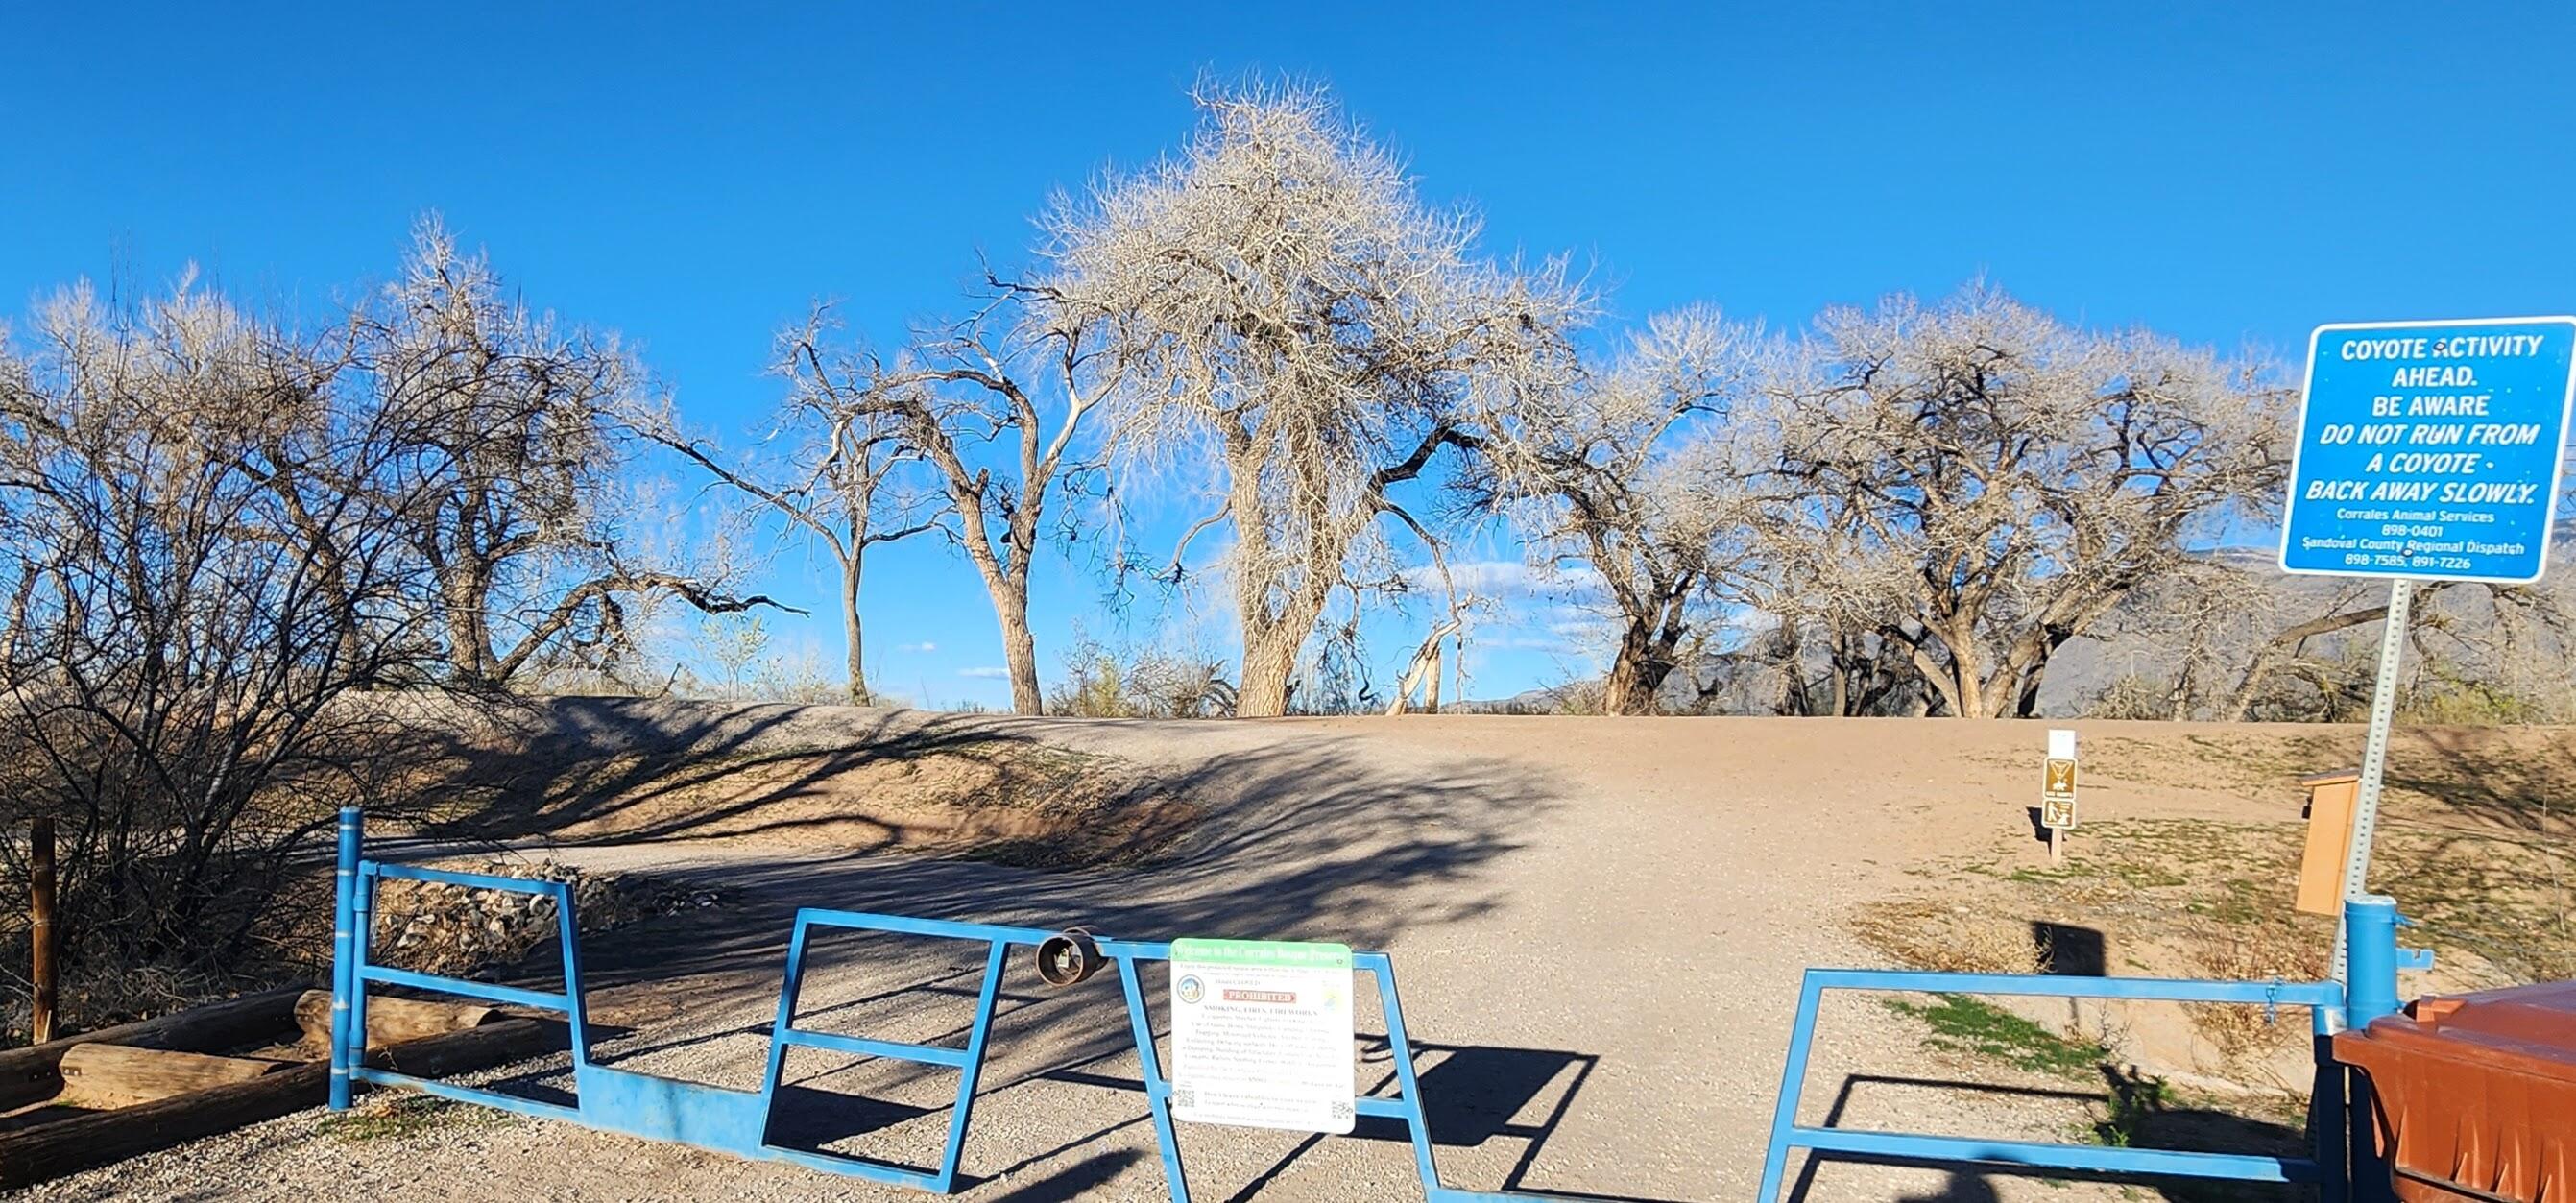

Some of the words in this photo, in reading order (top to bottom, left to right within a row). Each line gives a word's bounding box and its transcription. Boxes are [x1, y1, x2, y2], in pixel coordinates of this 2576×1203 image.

[2341, 338, 2428, 360] COYOTE
[2433, 335, 2544, 359] ACTIVITY
[2392, 366, 2478, 387] AHEAD.
[2372, 396, 2403, 416] BE
[2408, 395, 2491, 416] AWARE
[2320, 424, 2354, 445] DO
[2358, 424, 2408, 445] NOT
[2409, 424, 2465, 445] RUN
[2466, 423, 2540, 445] FROM
[2366, 453, 2383, 473] A
[2389, 453, 2482, 474] COYOTE
[2305, 480, 2368, 501] BACK
[2371, 481, 2439, 501] AWAY
[2439, 482, 2539, 504] SLOWLY.
[2337, 508, 2389, 520] Corrales
[2392, 510, 2437, 522] Animal
[2439, 511, 2495, 523] Services
[2381, 524, 2444, 537] 898-0401
[2302, 537, 2357, 548] Sandoval
[2359, 539, 2404, 552] County
[2407, 540, 2464, 553] Regional
[2466, 541, 2525, 555] Dispatch
[2345, 554, 2408, 567] 898-7585,
[2412, 557, 2471, 569] 891-7226
[1228, 991, 1292, 1002] PROHIBITED
